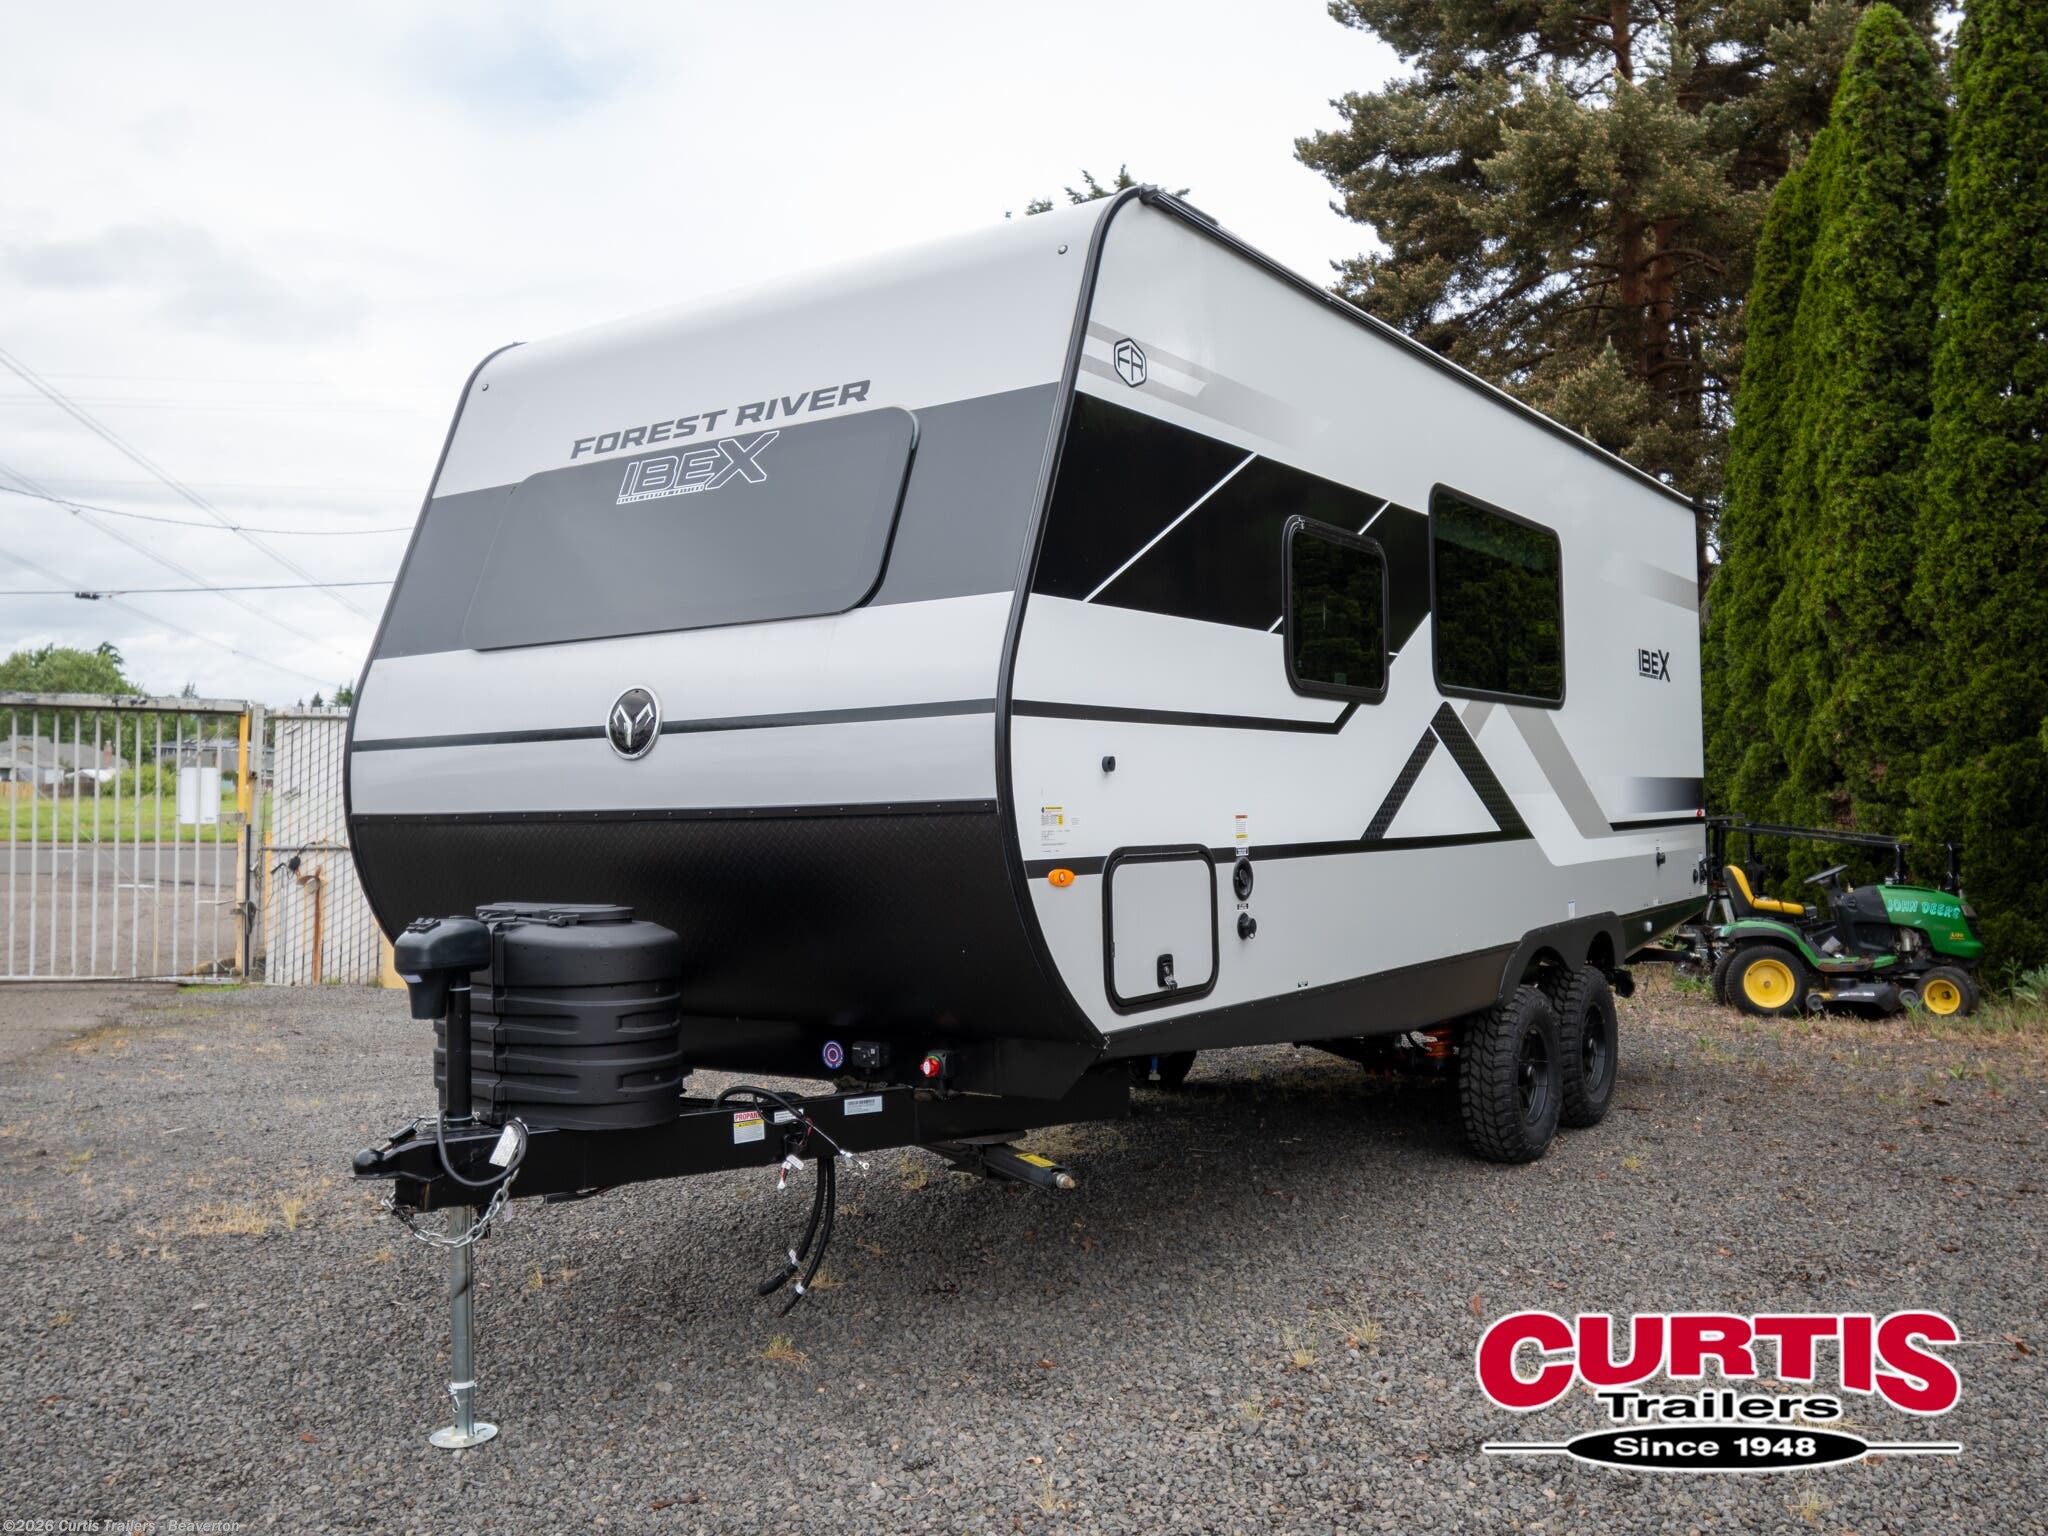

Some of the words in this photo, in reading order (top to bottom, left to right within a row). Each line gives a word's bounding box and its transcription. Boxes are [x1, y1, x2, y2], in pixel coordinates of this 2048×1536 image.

[570, 409, 728, 459] FOREST
[735, 379, 871, 427] RIVER
[618, 430, 779, 497] IBEX
[1638, 647, 1671, 682] IBEX
[1887, 898, 1918, 913] JOHN
